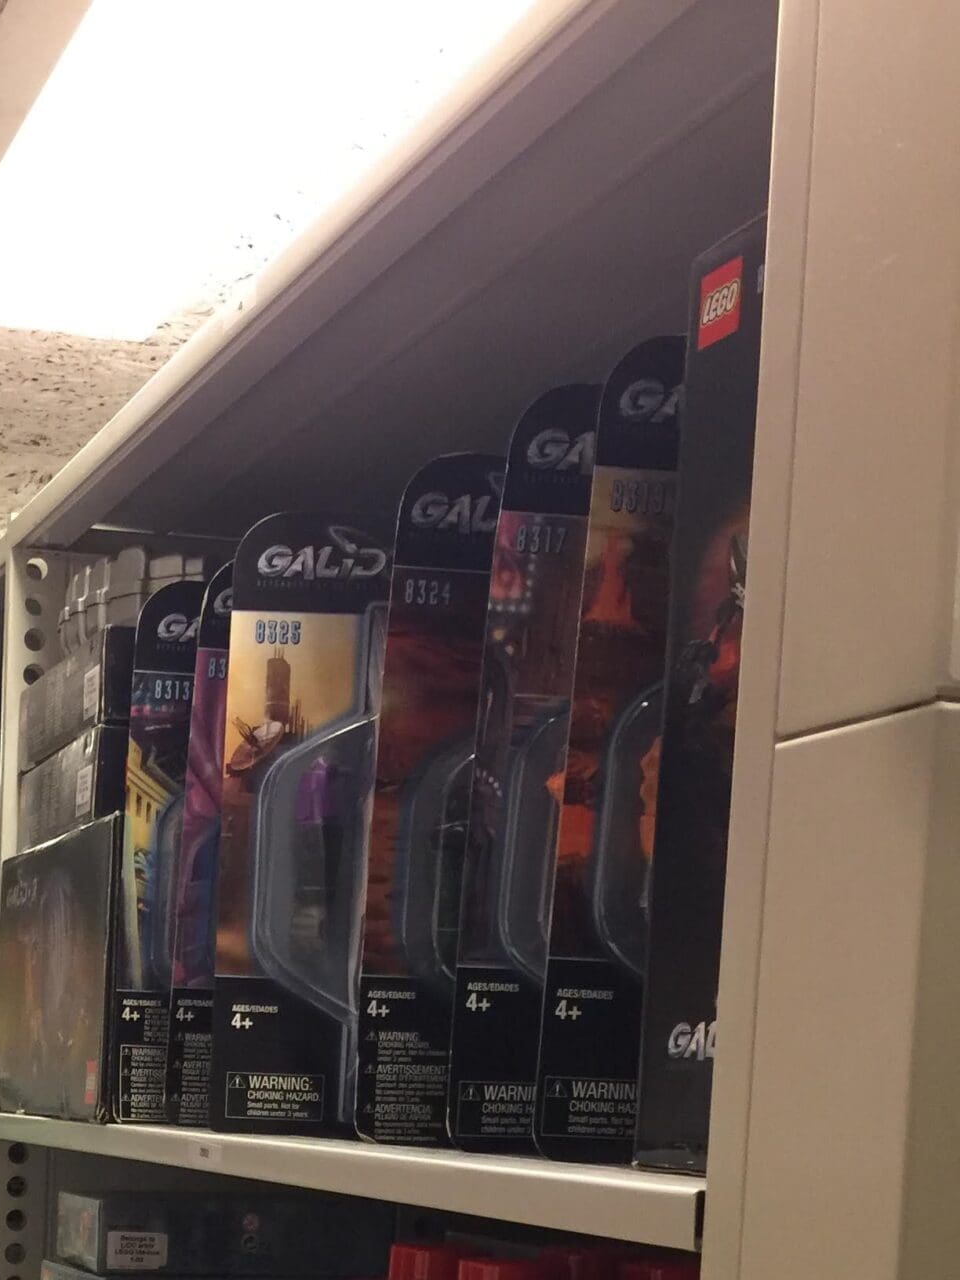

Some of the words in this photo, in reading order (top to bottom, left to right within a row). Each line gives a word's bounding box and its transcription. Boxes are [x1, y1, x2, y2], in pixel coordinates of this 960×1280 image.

[702, 279, 739, 326] LEGO
[516, 524, 567, 556] 8317
[404, 579, 451, 605] 8324
[255, 620, 301, 644] 8325
[155, 680, 190, 701] 8313
[467, 982, 519, 993] AGES/EDADES
[557, 988, 614, 1001] AGES/EDADES
[232, 1004, 279, 1014] AGES/EDADES
[367, 1001, 390, 1017] 4+
[466, 993, 491, 1011] 4+
[555, 1000, 582, 1020] 4+
[121, 1007, 141, 1021] 4+
[176, 1007, 195, 1022] 4+
[231, 1013, 254, 1029] 4+
[247, 1090, 284, 1100] CHOKING
[482, 1102, 523, 1113] CHOKING
[569, 1100, 614, 1113] CHOKING
